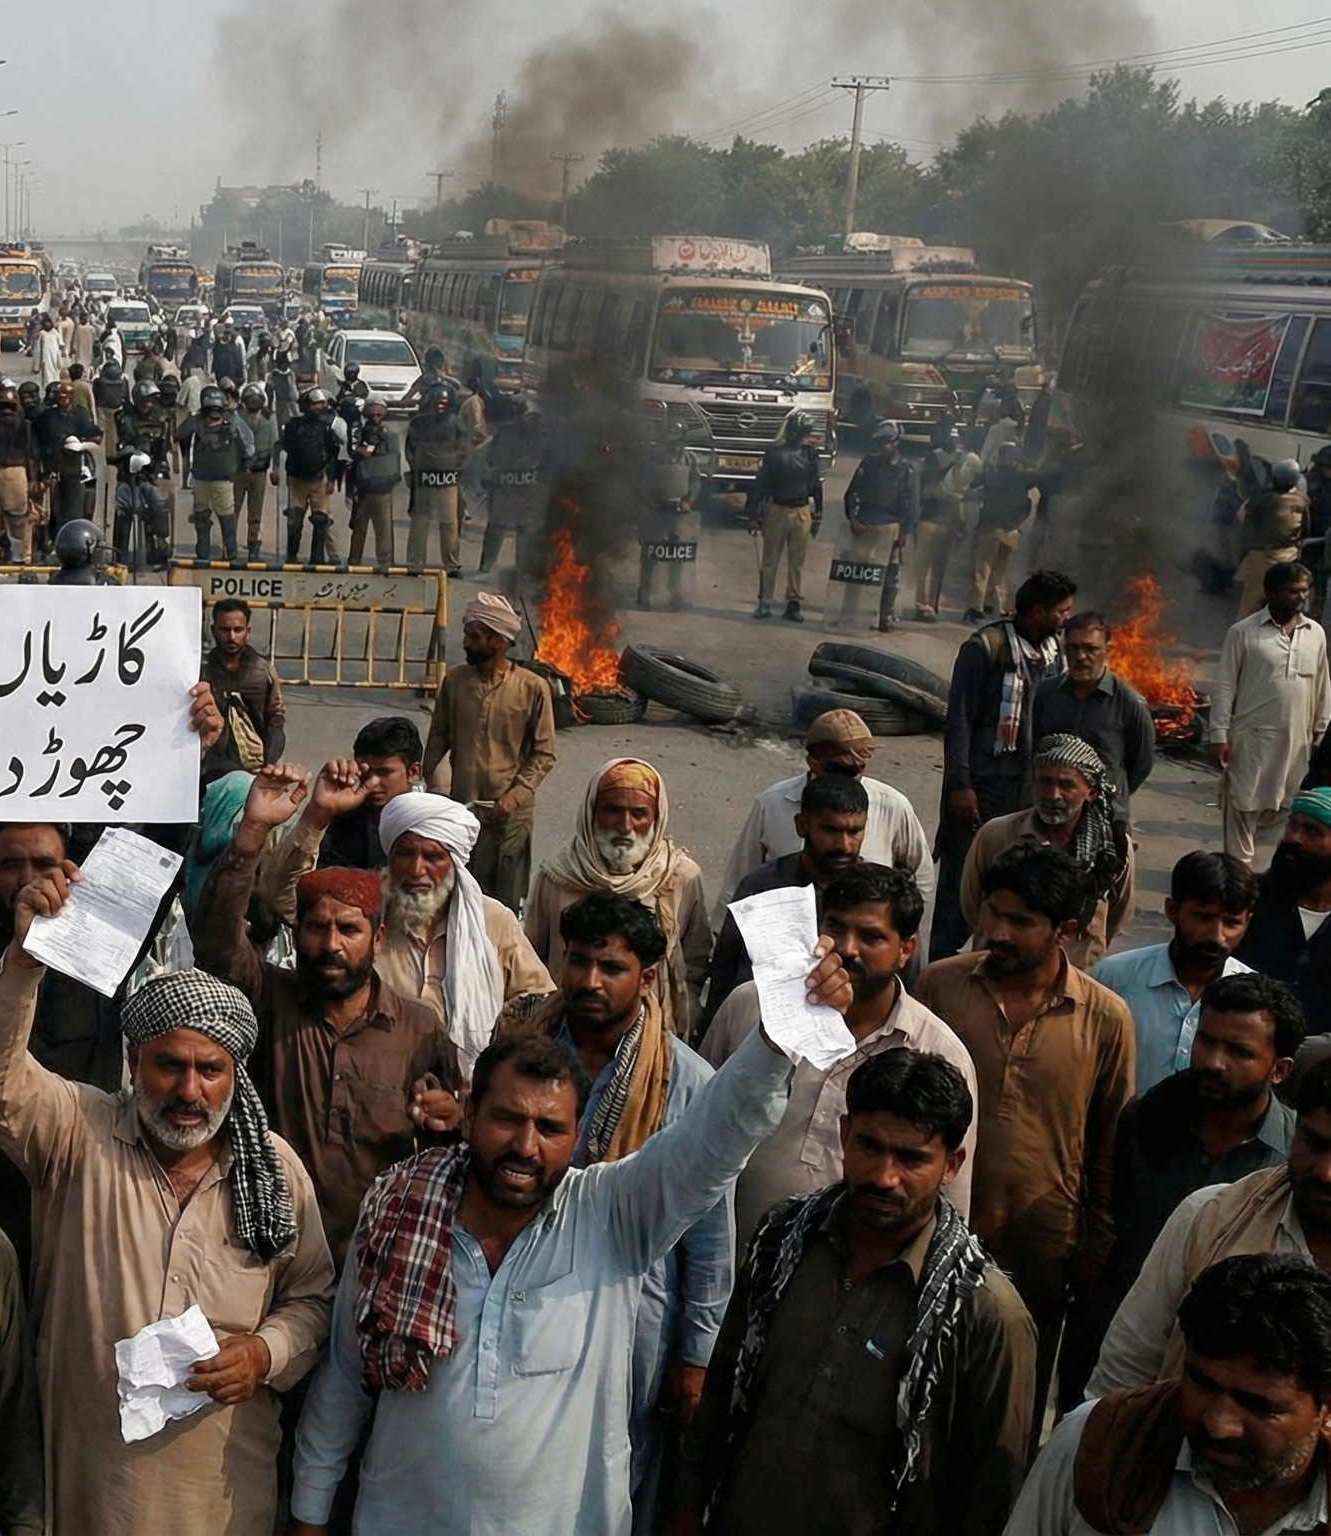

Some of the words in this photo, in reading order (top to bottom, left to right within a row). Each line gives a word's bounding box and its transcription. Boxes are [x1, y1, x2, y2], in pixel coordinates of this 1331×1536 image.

[647, 544, 694, 559] POLICE
[835, 563, 882, 582] POLICE
[210, 577, 283, 598] POLICE
[28, 723, 146, 811] چھوڑ
